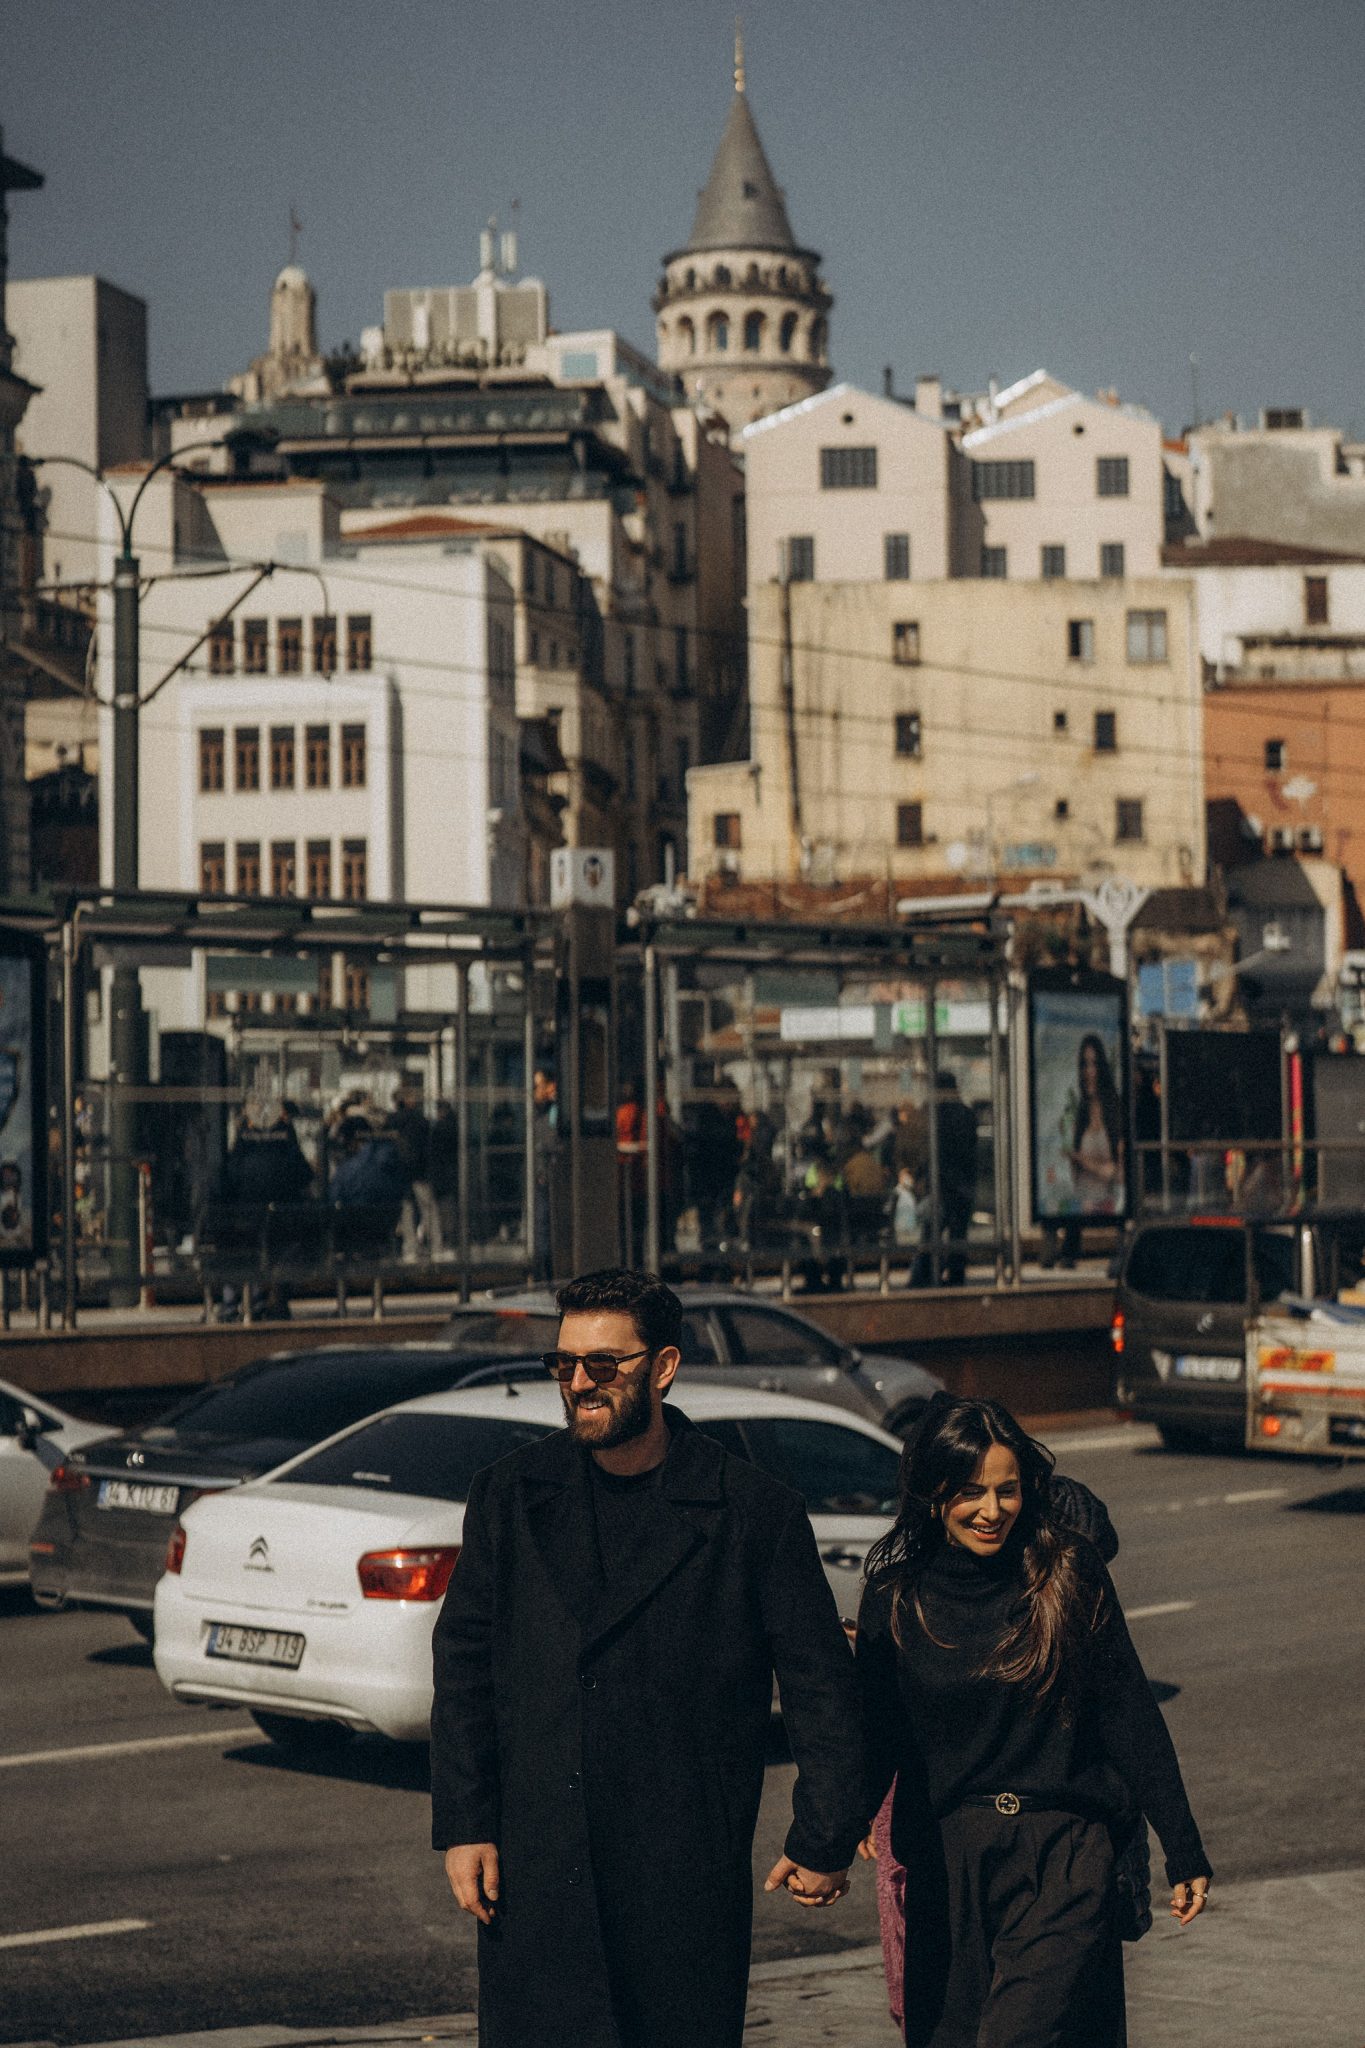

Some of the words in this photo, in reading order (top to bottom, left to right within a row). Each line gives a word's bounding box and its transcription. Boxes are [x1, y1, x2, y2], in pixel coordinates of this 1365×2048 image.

[215, 1627, 234, 1649] 34
[238, 1630, 267, 1653] BSP
[273, 1634, 300, 1658] 119
